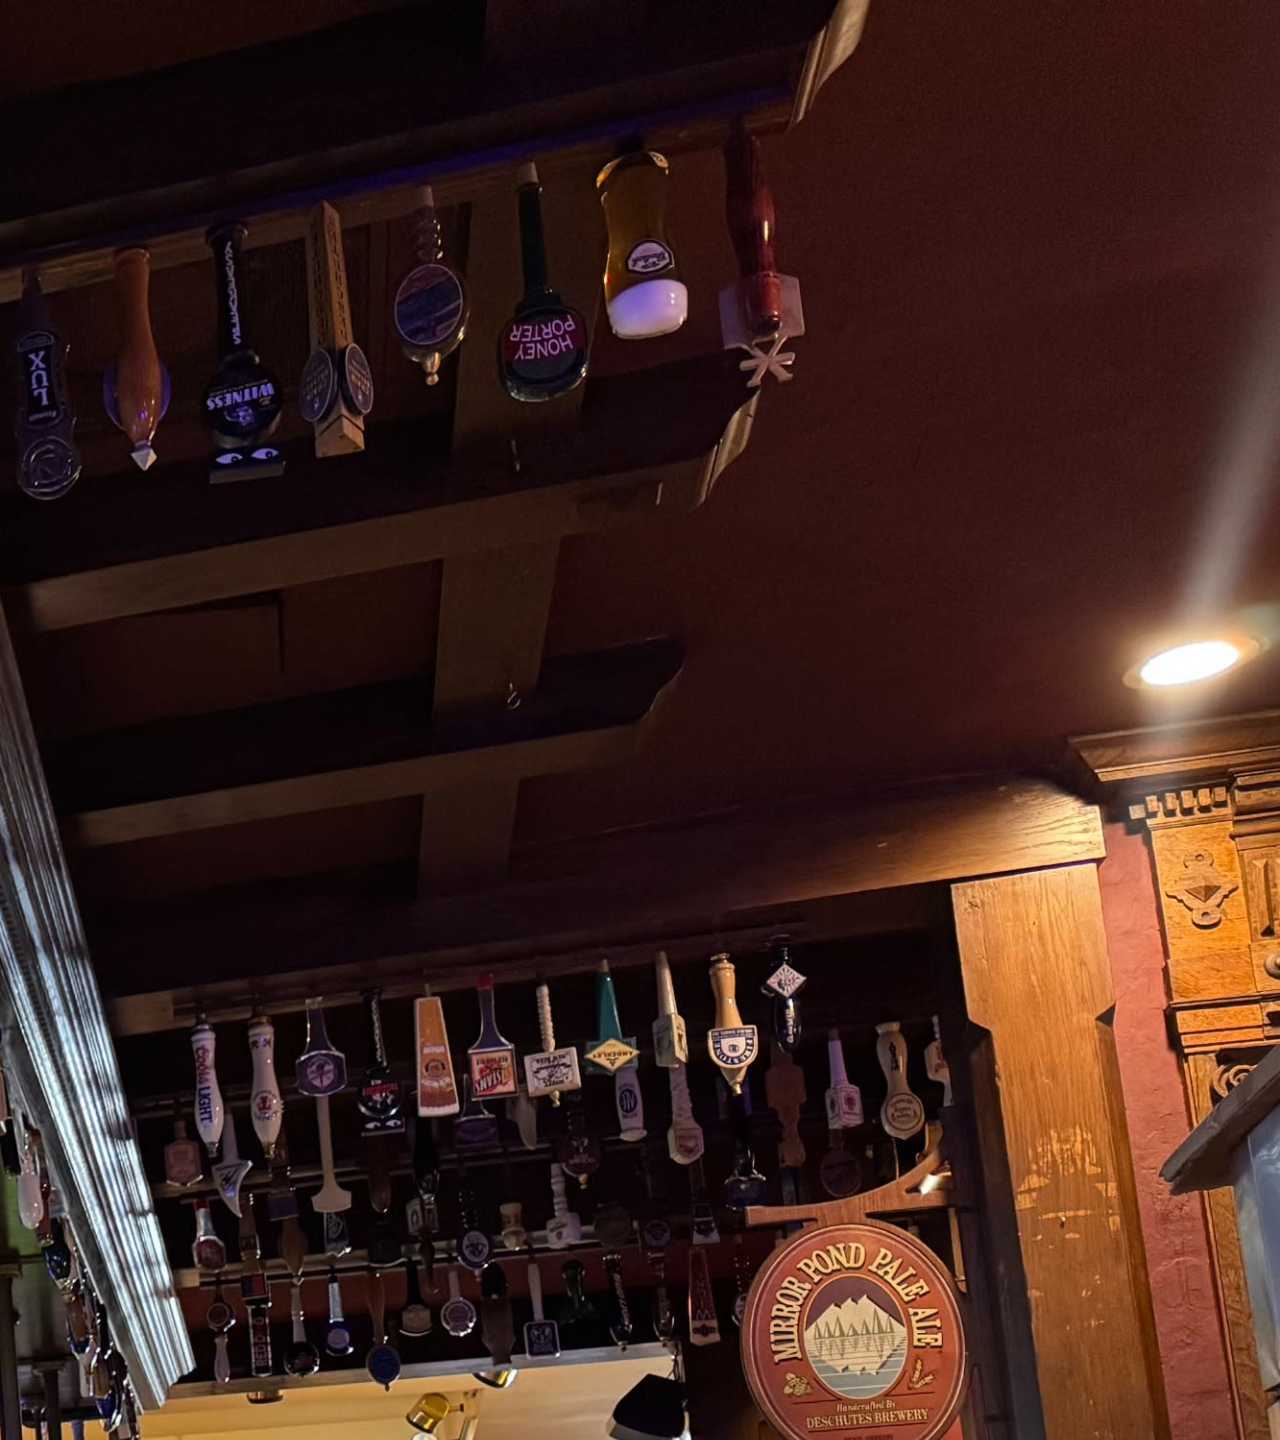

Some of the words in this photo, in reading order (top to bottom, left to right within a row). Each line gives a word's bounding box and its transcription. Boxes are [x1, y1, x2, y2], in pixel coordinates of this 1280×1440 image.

[509, 313, 576, 342] PORTER
[514, 335, 573, 361] HONEY
[206, 382, 276, 411] WITNESS
[195, 1084, 214, 1126] LIGHT
[769, 1274, 812, 1366] MIRROR
[797, 1241, 866, 1286] POND
[867, 1246, 929, 1304] PALE
[908, 1304, 944, 1350] ALE
[806, 1413, 873, 1430] DESCHUTES
[874, 1408, 929, 1424] BREWERY
